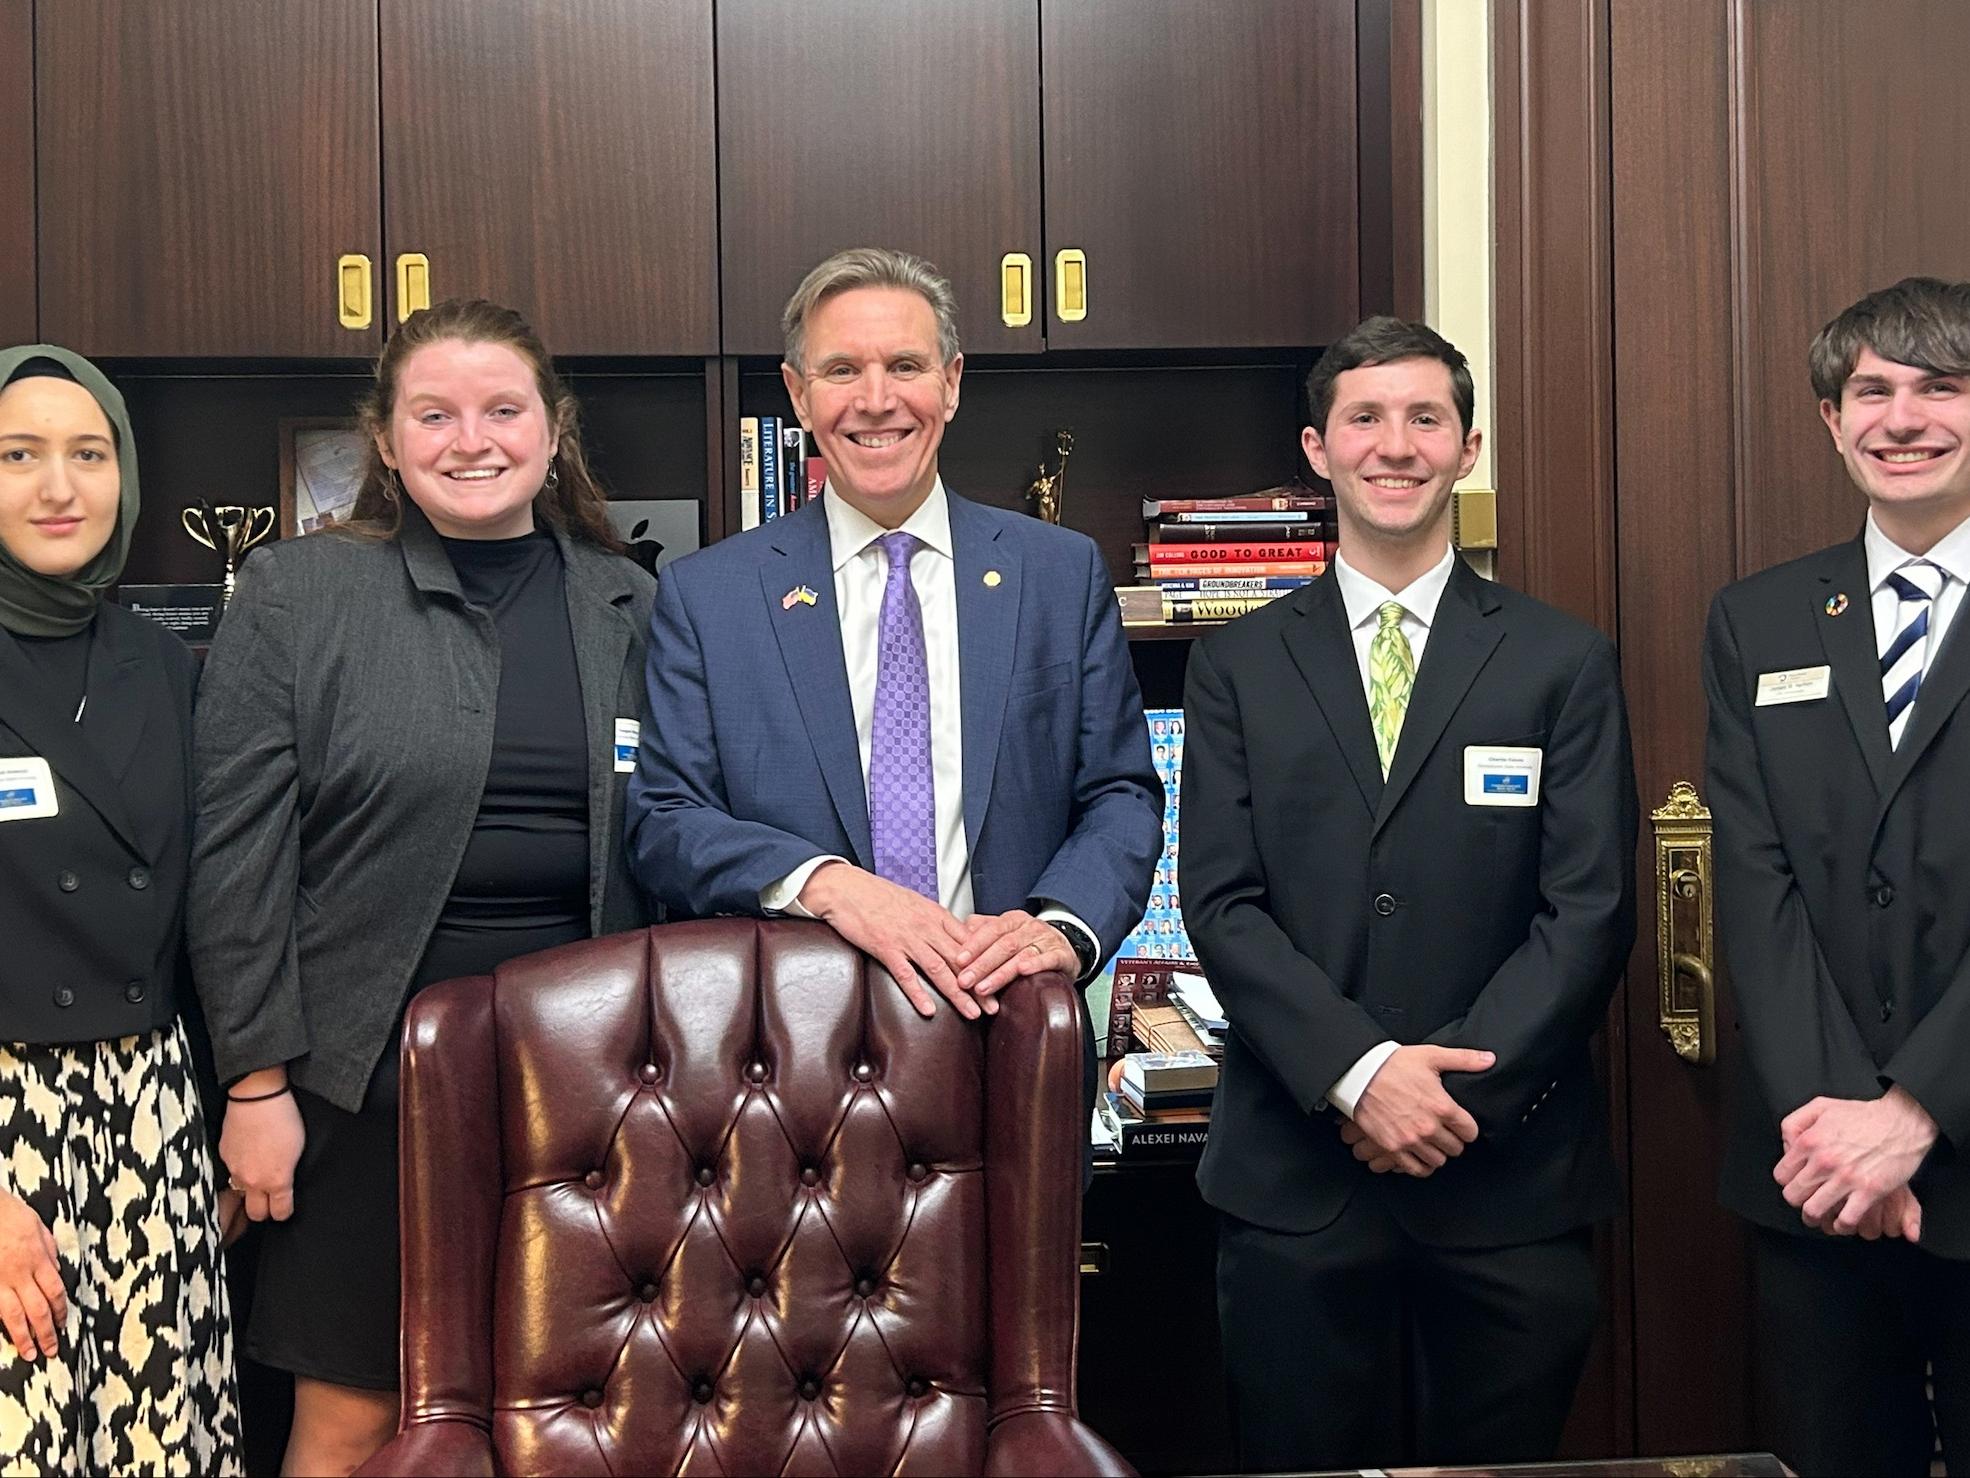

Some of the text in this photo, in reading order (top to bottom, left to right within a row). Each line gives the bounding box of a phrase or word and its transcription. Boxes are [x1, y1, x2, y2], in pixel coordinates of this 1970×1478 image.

[763, 423, 775, 490] LITERATURE
[766, 495, 775, 507] IN
[1190, 549, 1227, 559] GOOD
[1234, 549, 1252, 558] TO
[1258, 547, 1303, 558] GREAT
[1202, 580, 1263, 589] GROUNDBREAKERS
[1132, 1133, 1175, 1145] ALEXEI
